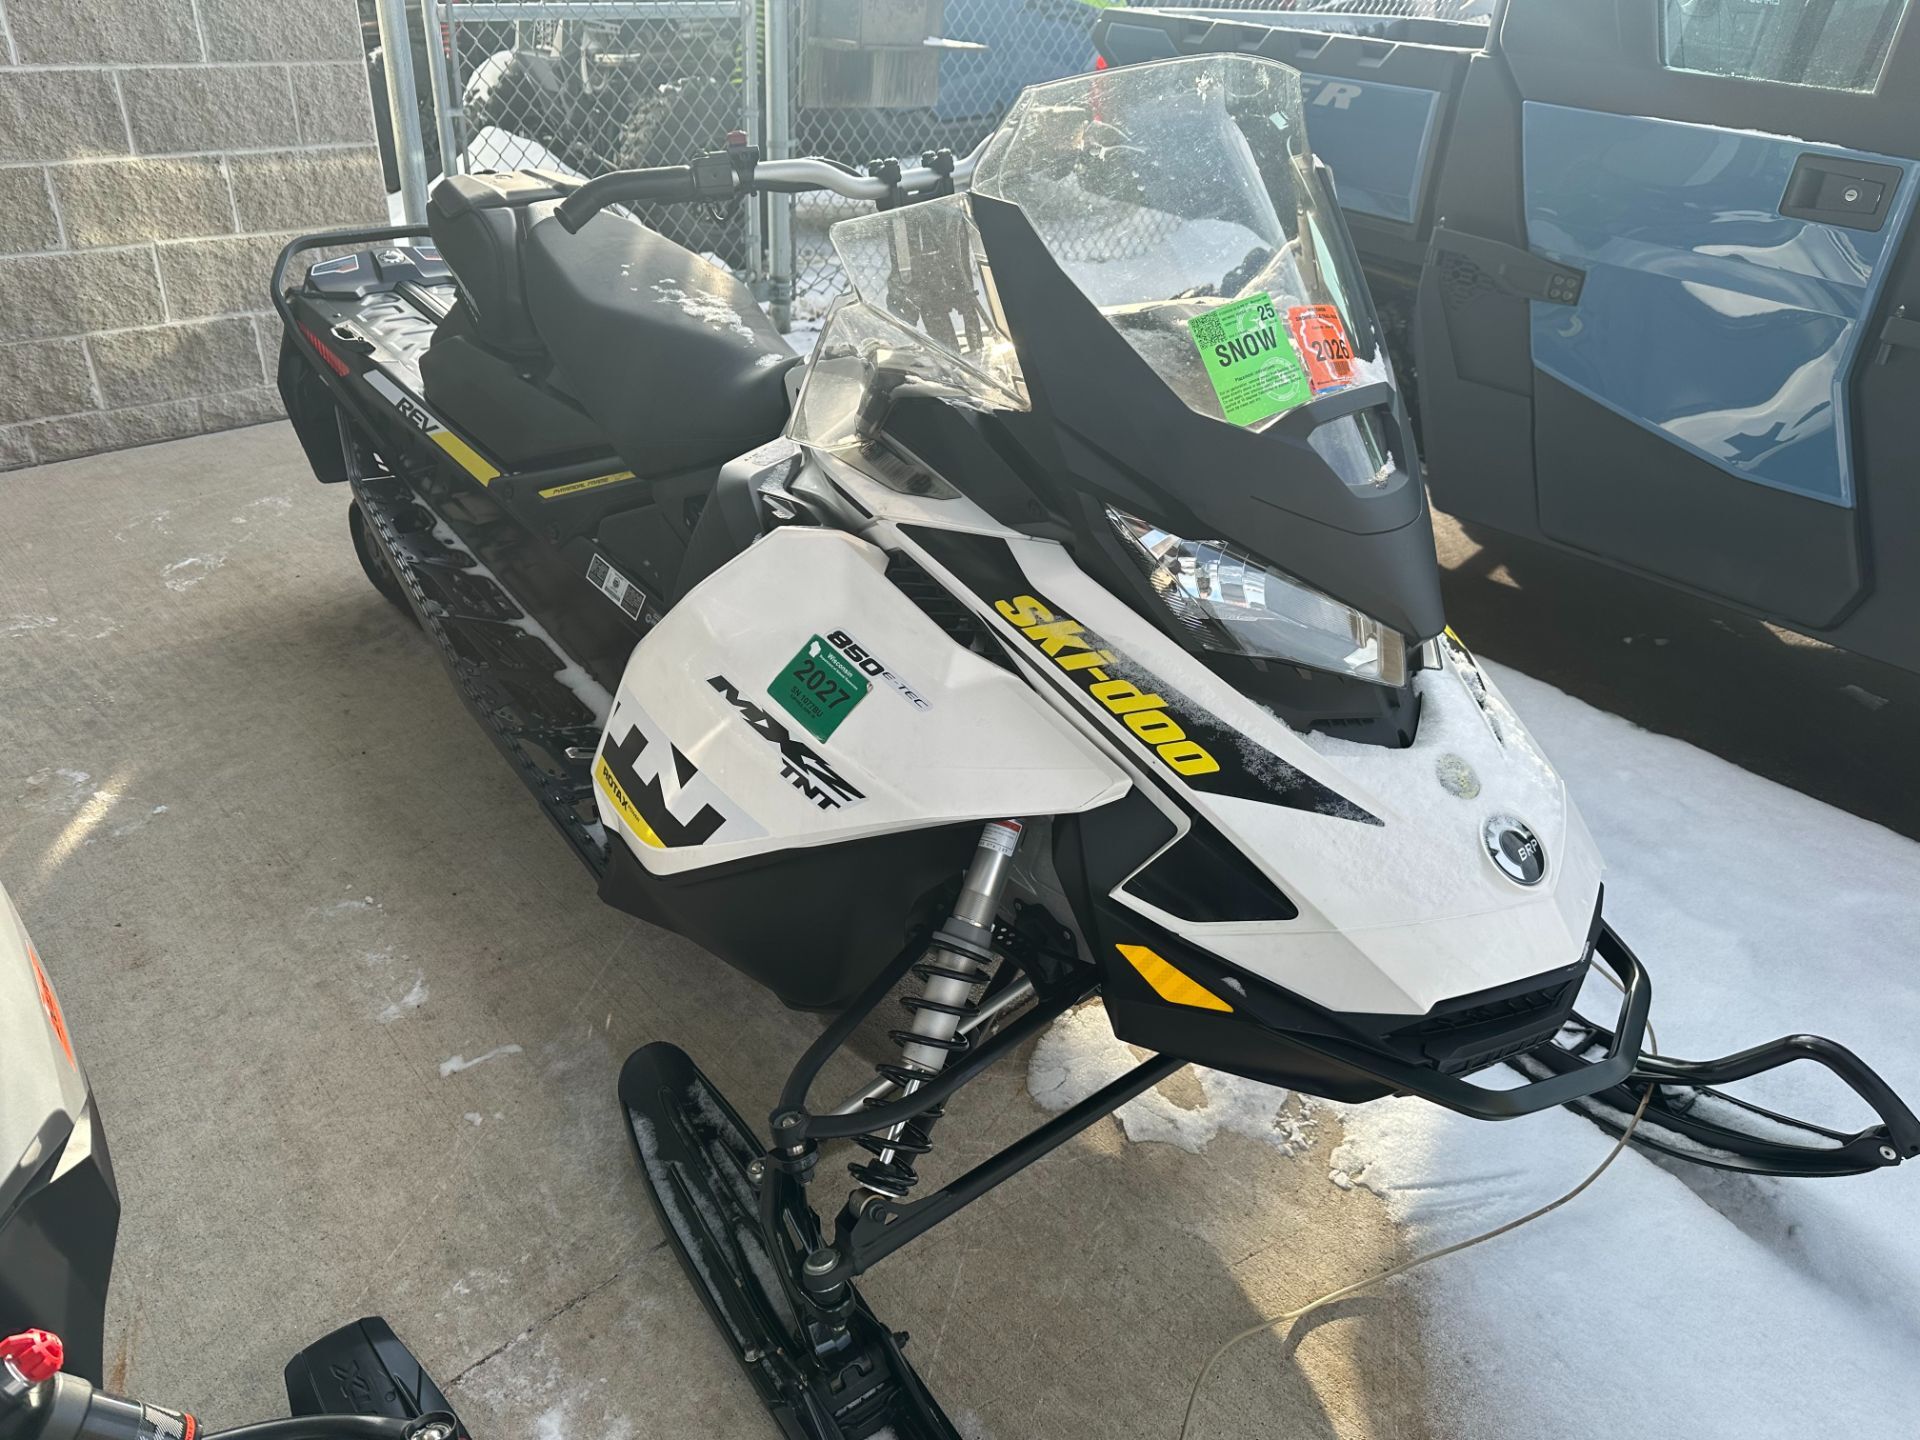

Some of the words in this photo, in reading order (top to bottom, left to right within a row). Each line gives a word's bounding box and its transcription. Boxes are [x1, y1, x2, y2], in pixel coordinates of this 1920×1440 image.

[1257, 303, 1275, 321] 25
[1215, 326, 1278, 367] SNOW
[1312, 339, 1350, 362] 2026
[395, 396, 440, 434] REV
[793, 658, 851, 710] 2027
[826, 630, 885, 677] 850
[882, 672, 930, 711] E-TEC
[827, 652, 854, 678] Wisconsin
[603, 766, 628, 810] ROTAX
[779, 757, 841, 810] TNT
[1517, 838, 1540, 864] BRP
